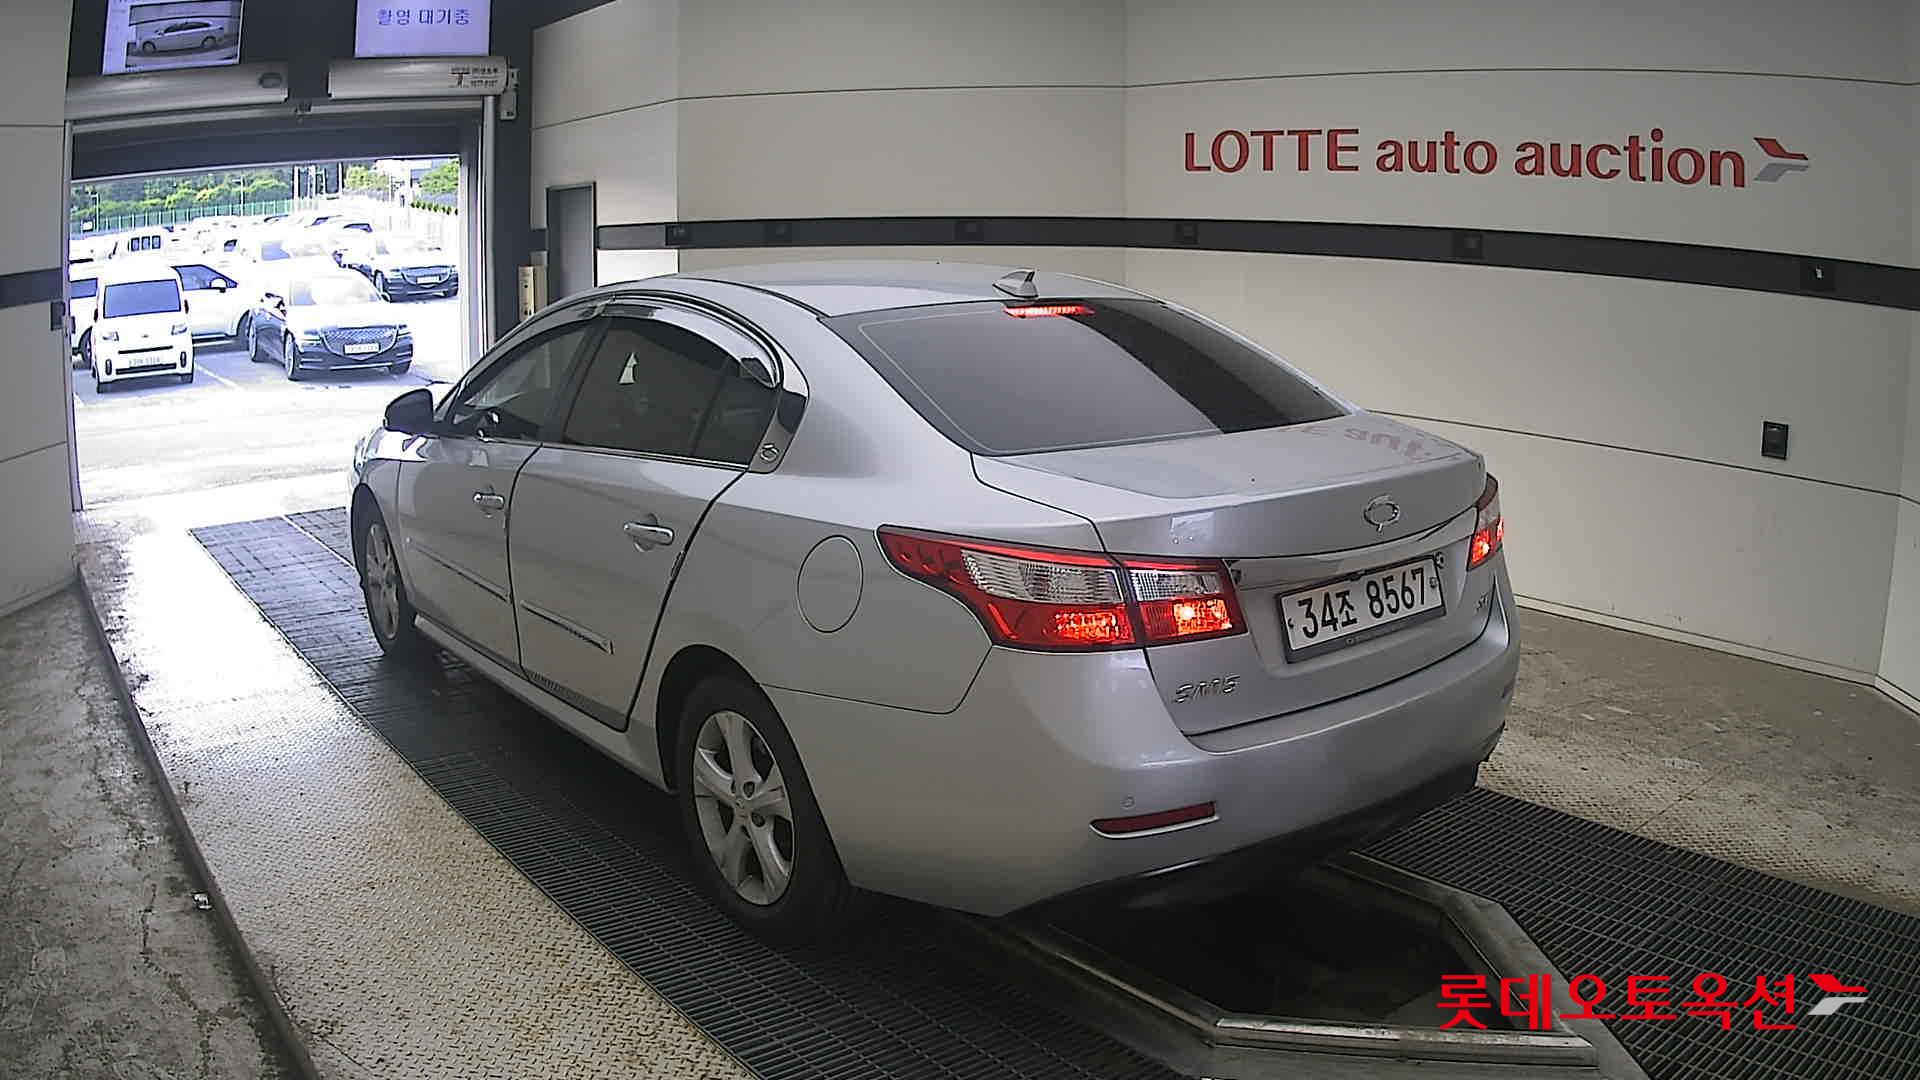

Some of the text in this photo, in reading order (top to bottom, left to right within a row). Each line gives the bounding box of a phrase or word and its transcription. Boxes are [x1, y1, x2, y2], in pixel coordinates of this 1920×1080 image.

[419, 8, 471, 26] 대기중
[1184, 129, 1746, 187] LOTTE auto auction
[1297, 590, 1358, 639] 34조
[1367, 568, 1425, 619] 8567
